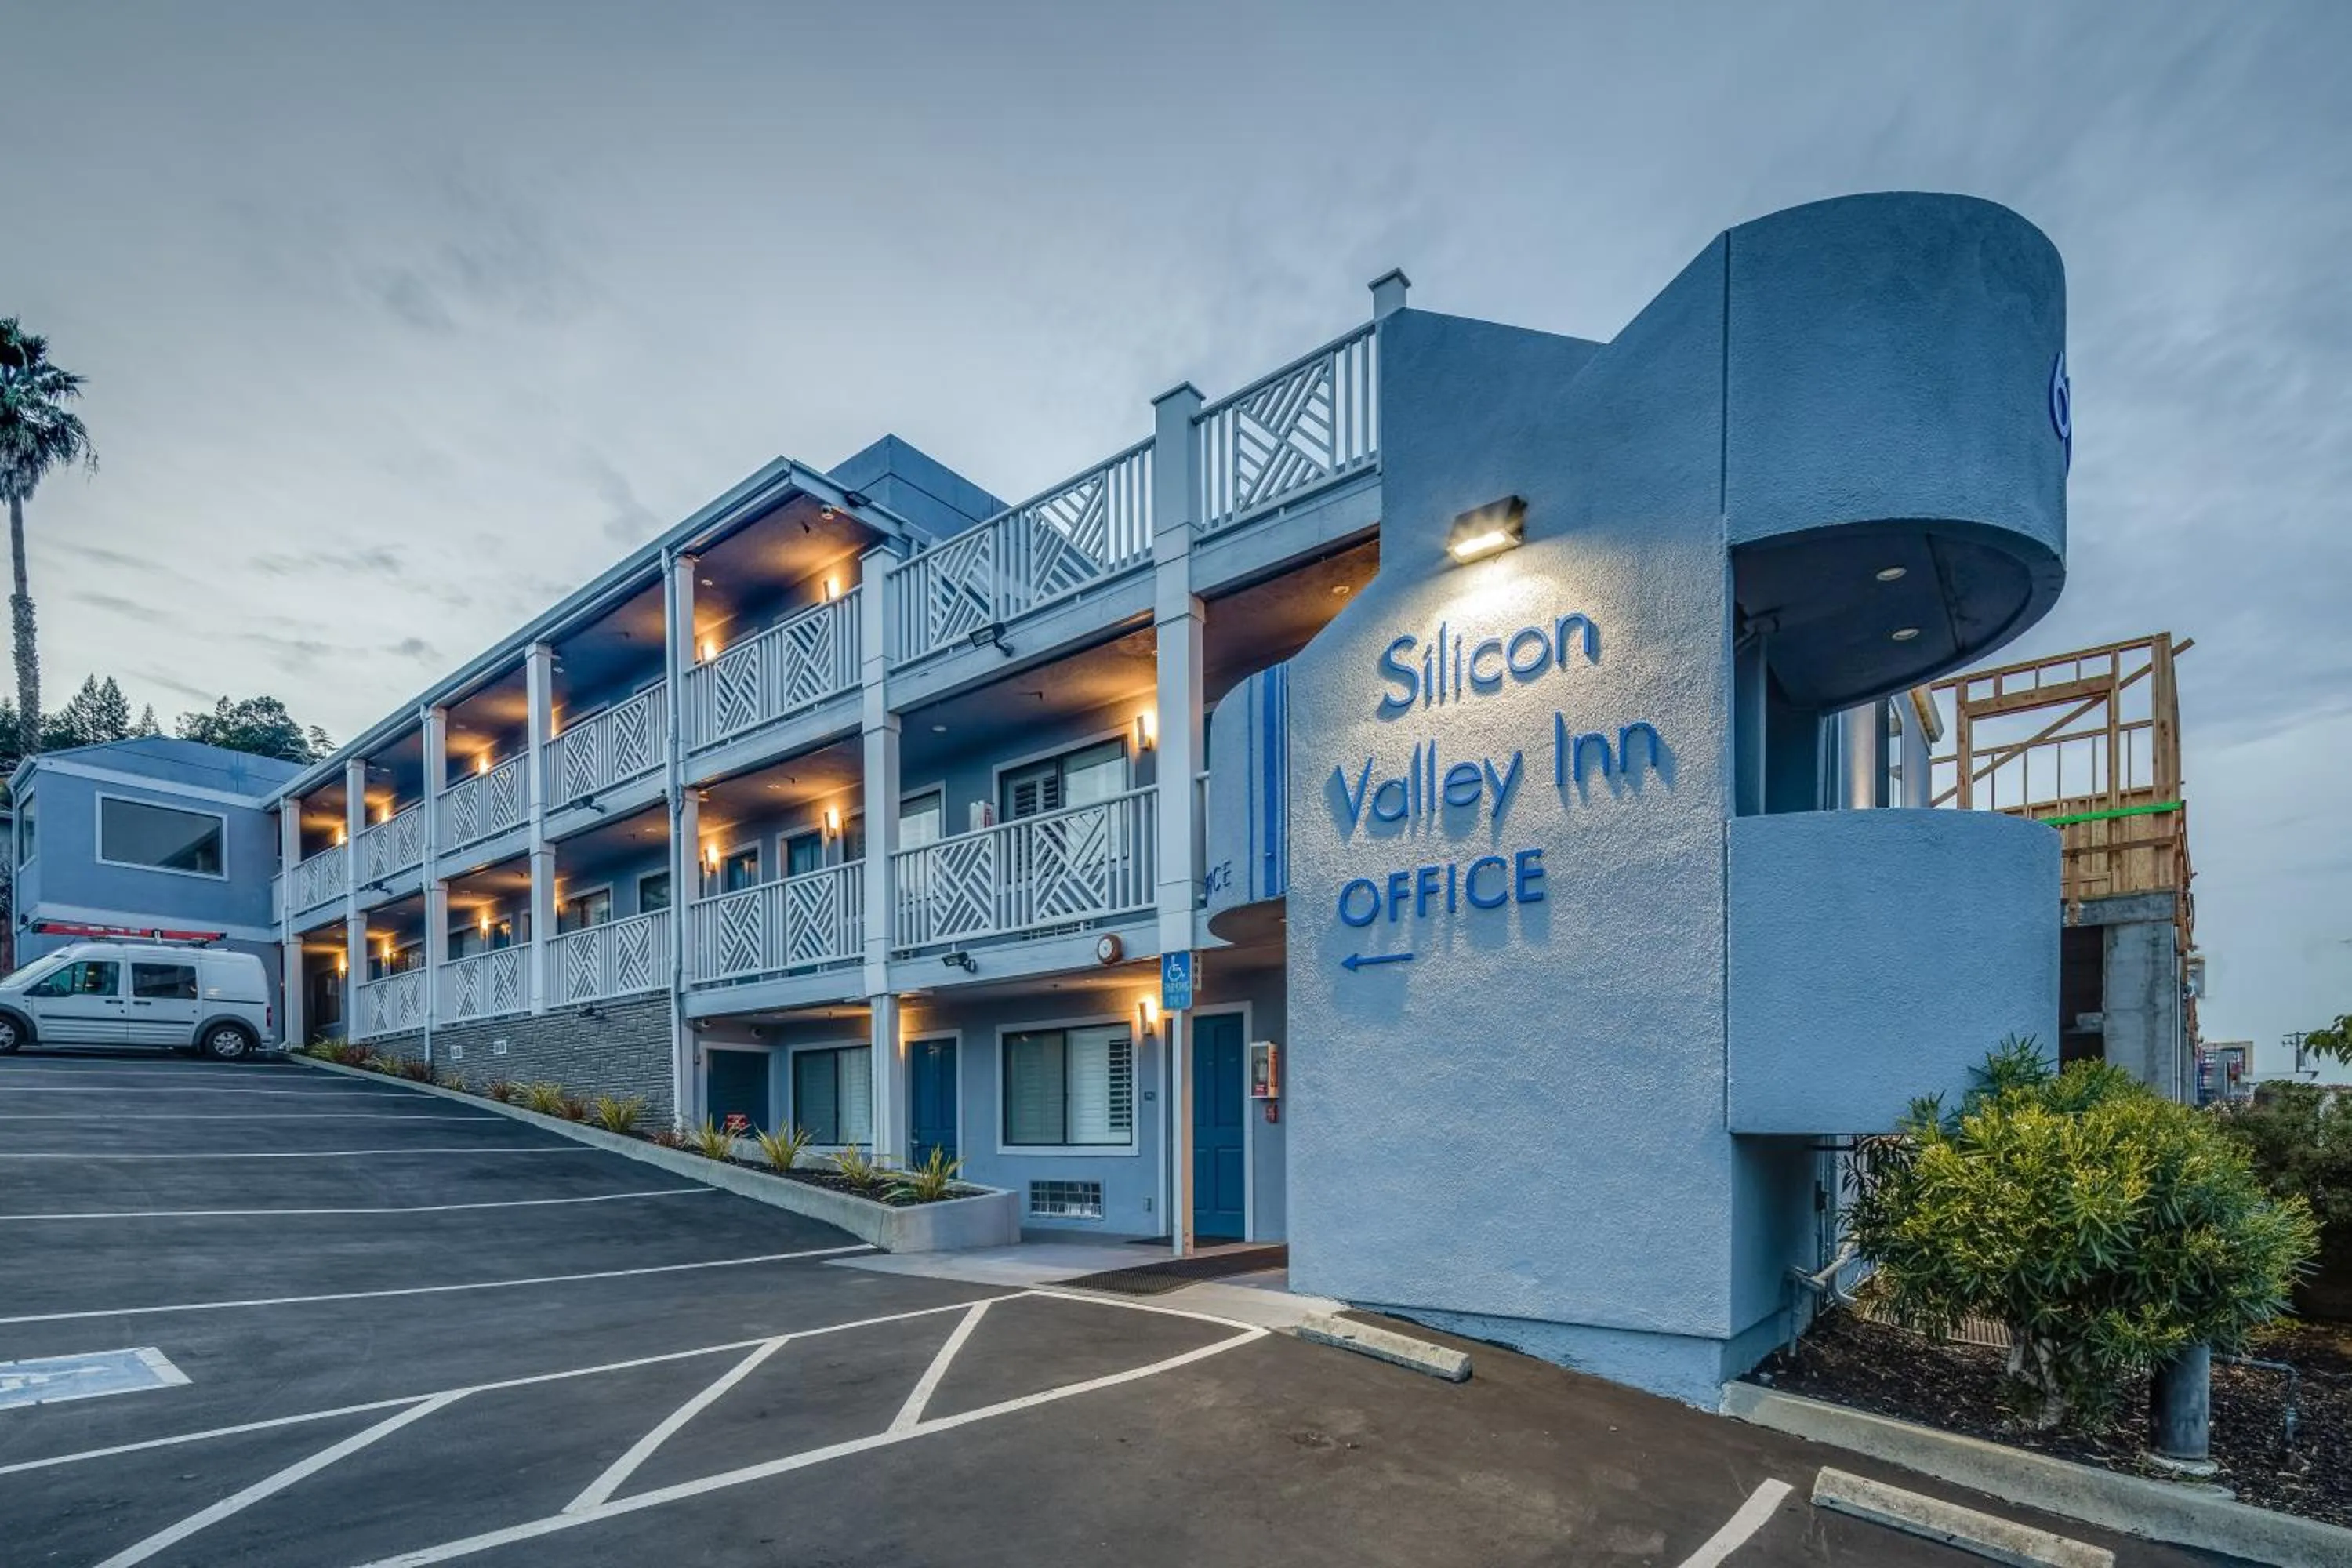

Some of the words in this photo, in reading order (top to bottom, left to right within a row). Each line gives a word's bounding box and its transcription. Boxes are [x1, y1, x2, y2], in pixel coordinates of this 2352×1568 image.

[1382, 612, 1592, 707] Silicon
[1334, 738, 1523, 824] Valley
[1554, 710, 1658, 786] Inn
[1338, 848, 1546, 928] OFFICE
